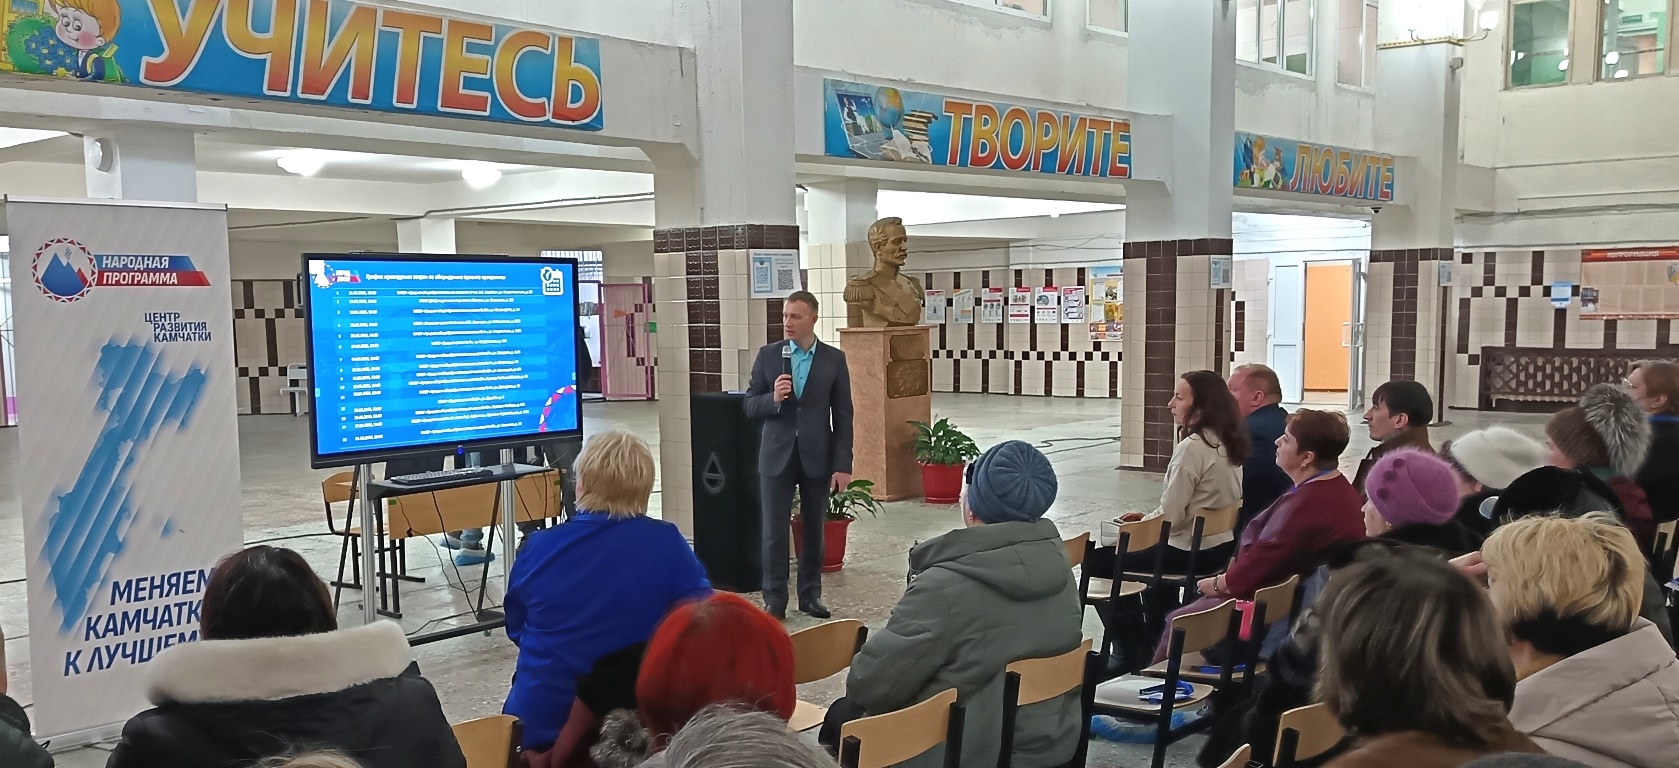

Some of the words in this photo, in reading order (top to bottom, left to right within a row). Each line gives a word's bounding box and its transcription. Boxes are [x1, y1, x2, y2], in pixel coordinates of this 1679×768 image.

[139, 0, 602, 124] УЧИТЕСЬ
[943, 98, 1131, 178] ТВОРИТЕ
[1289, 144, 1394, 200] ЛЮБИТЕ
[102, 255, 170, 270] НАРОДНАЯ
[102, 272, 178, 285] ПРОГРАММА
[144, 312, 180, 324] ЦЕНТР
[153, 321, 207, 333] РАЗВИТИЯ
[154, 331, 212, 342] КАМЧАТКИ
[84, 599, 202, 642] КАМЧАТК
[63, 650, 82, 677] К
